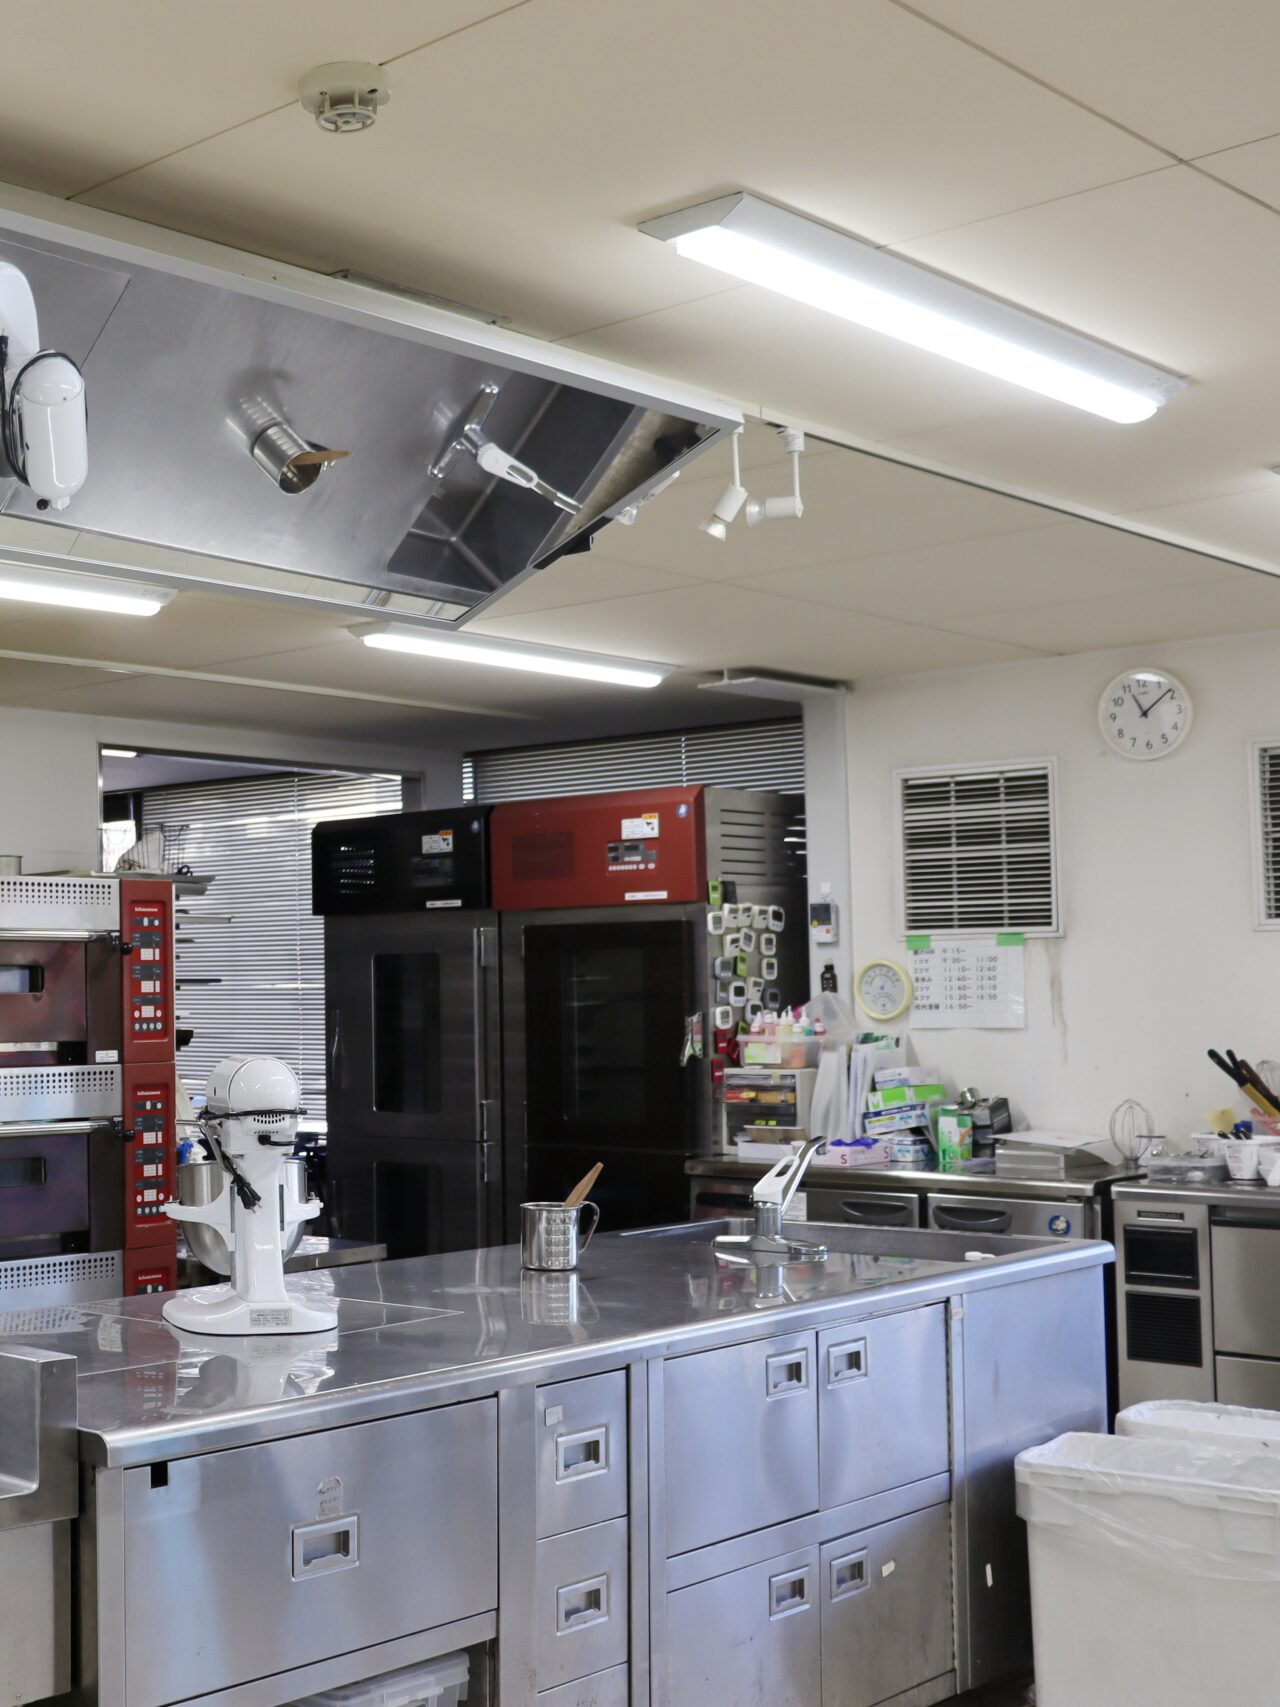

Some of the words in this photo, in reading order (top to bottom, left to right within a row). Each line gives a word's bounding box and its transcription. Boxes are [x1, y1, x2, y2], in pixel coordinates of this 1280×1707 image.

[1122, 684, 1132, 694] 11
[1170, 689, 1176, 700] 2
[1112, 696, 1124, 707] 10
[1176, 704, 1182, 715] 3
[1110, 713, 1117, 723] 9
[1171, 721, 1178, 731] 4
[1117, 728, 1124, 739] 8
[1161, 733, 1168, 744] 5
[1129, 737, 1137, 748] 7
[1146, 740, 1153, 750] 6
[883, 1146, 889, 1159] S
[840, 1154, 848, 1164] S
